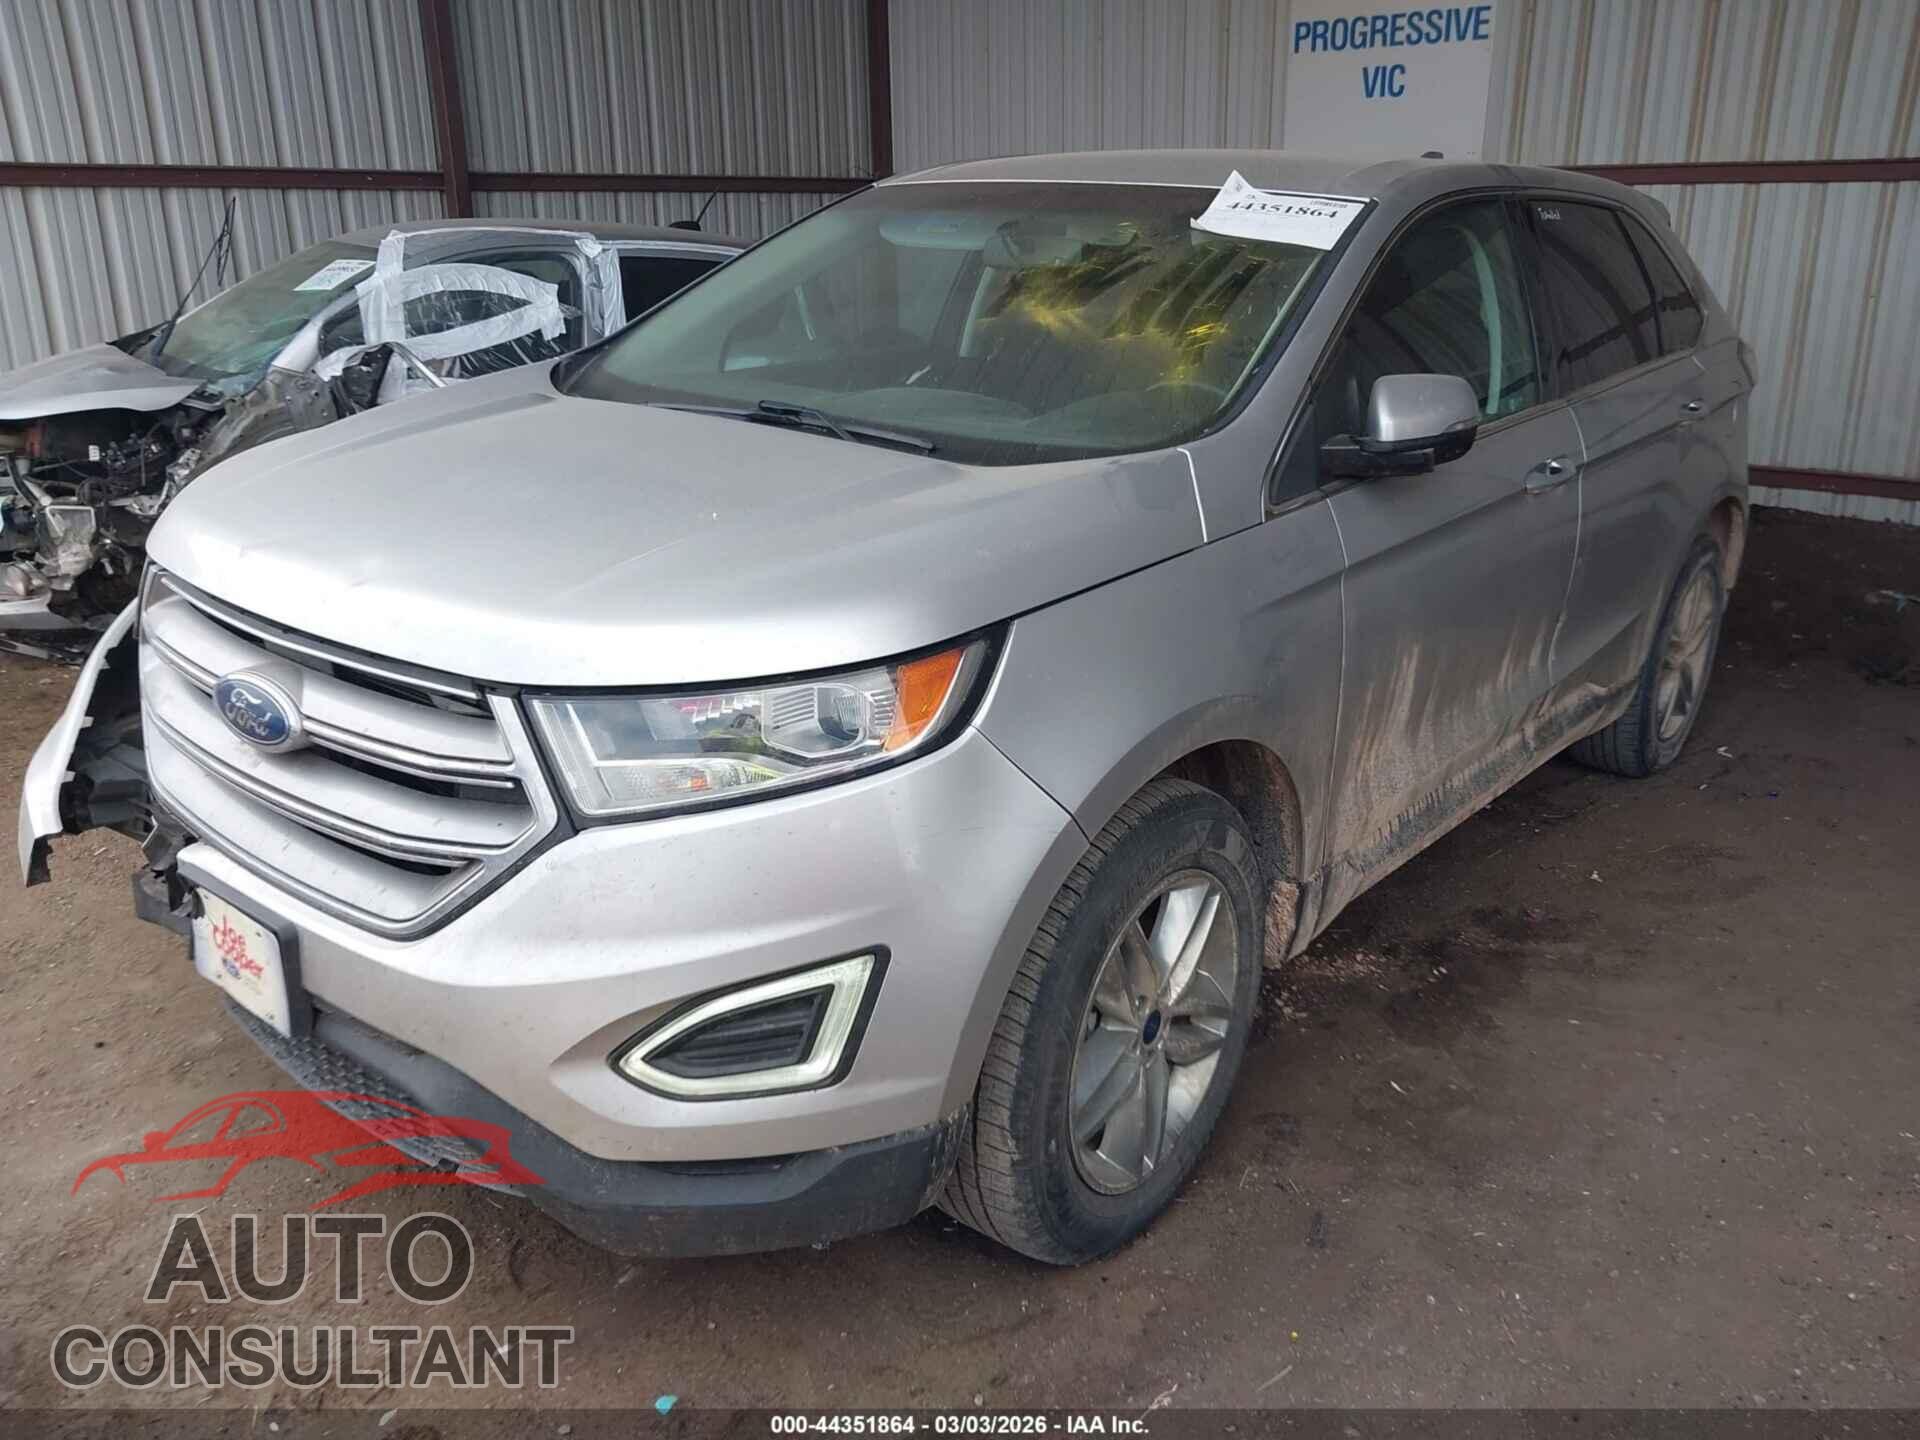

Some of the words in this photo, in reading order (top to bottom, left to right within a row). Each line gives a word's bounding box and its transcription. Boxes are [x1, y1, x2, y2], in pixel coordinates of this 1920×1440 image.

[1293, 5, 1492, 54] PROGRESSIVE
[1362, 64, 1406, 98] VIC
[1226, 201, 1339, 219] 44351864
[224, 687, 273, 737] Ford
